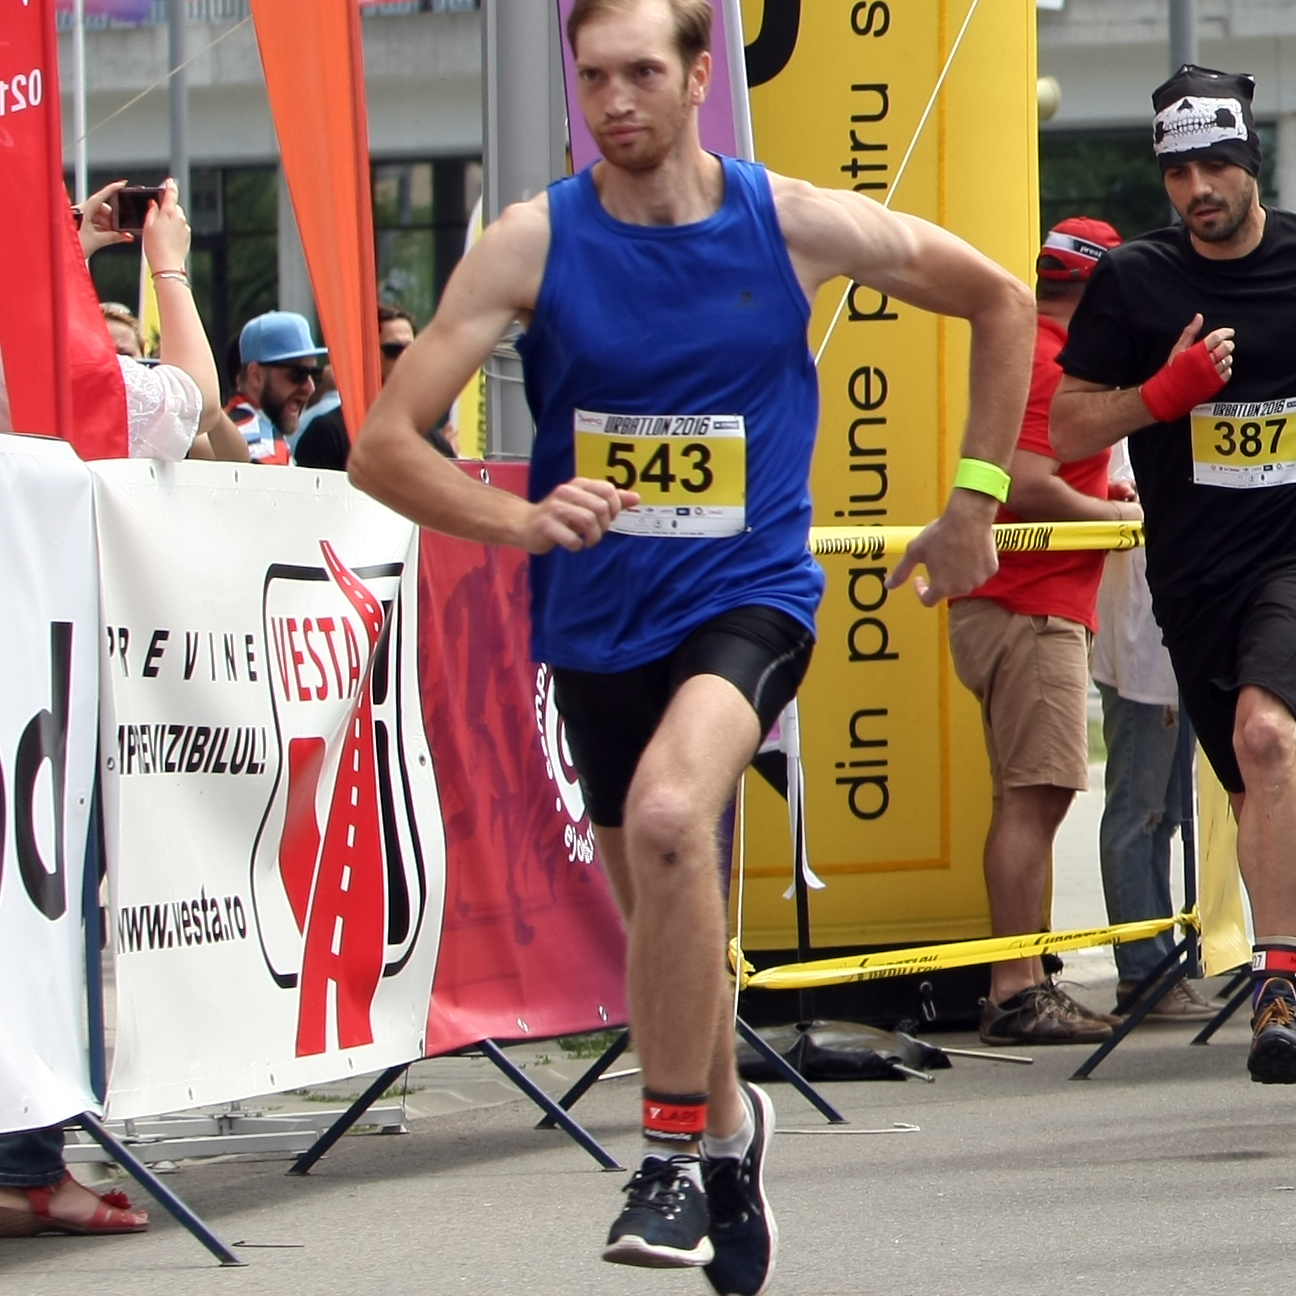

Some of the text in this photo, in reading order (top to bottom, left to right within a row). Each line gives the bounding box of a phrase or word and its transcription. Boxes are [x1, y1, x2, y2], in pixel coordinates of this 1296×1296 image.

[604, 415, 711, 436] URBATLON 2016
[1213, 418, 1288, 458] 387
[605, 441, 714, 494] 543
[270, 616, 363, 703] VESTA
[835, 708, 888, 821] din
